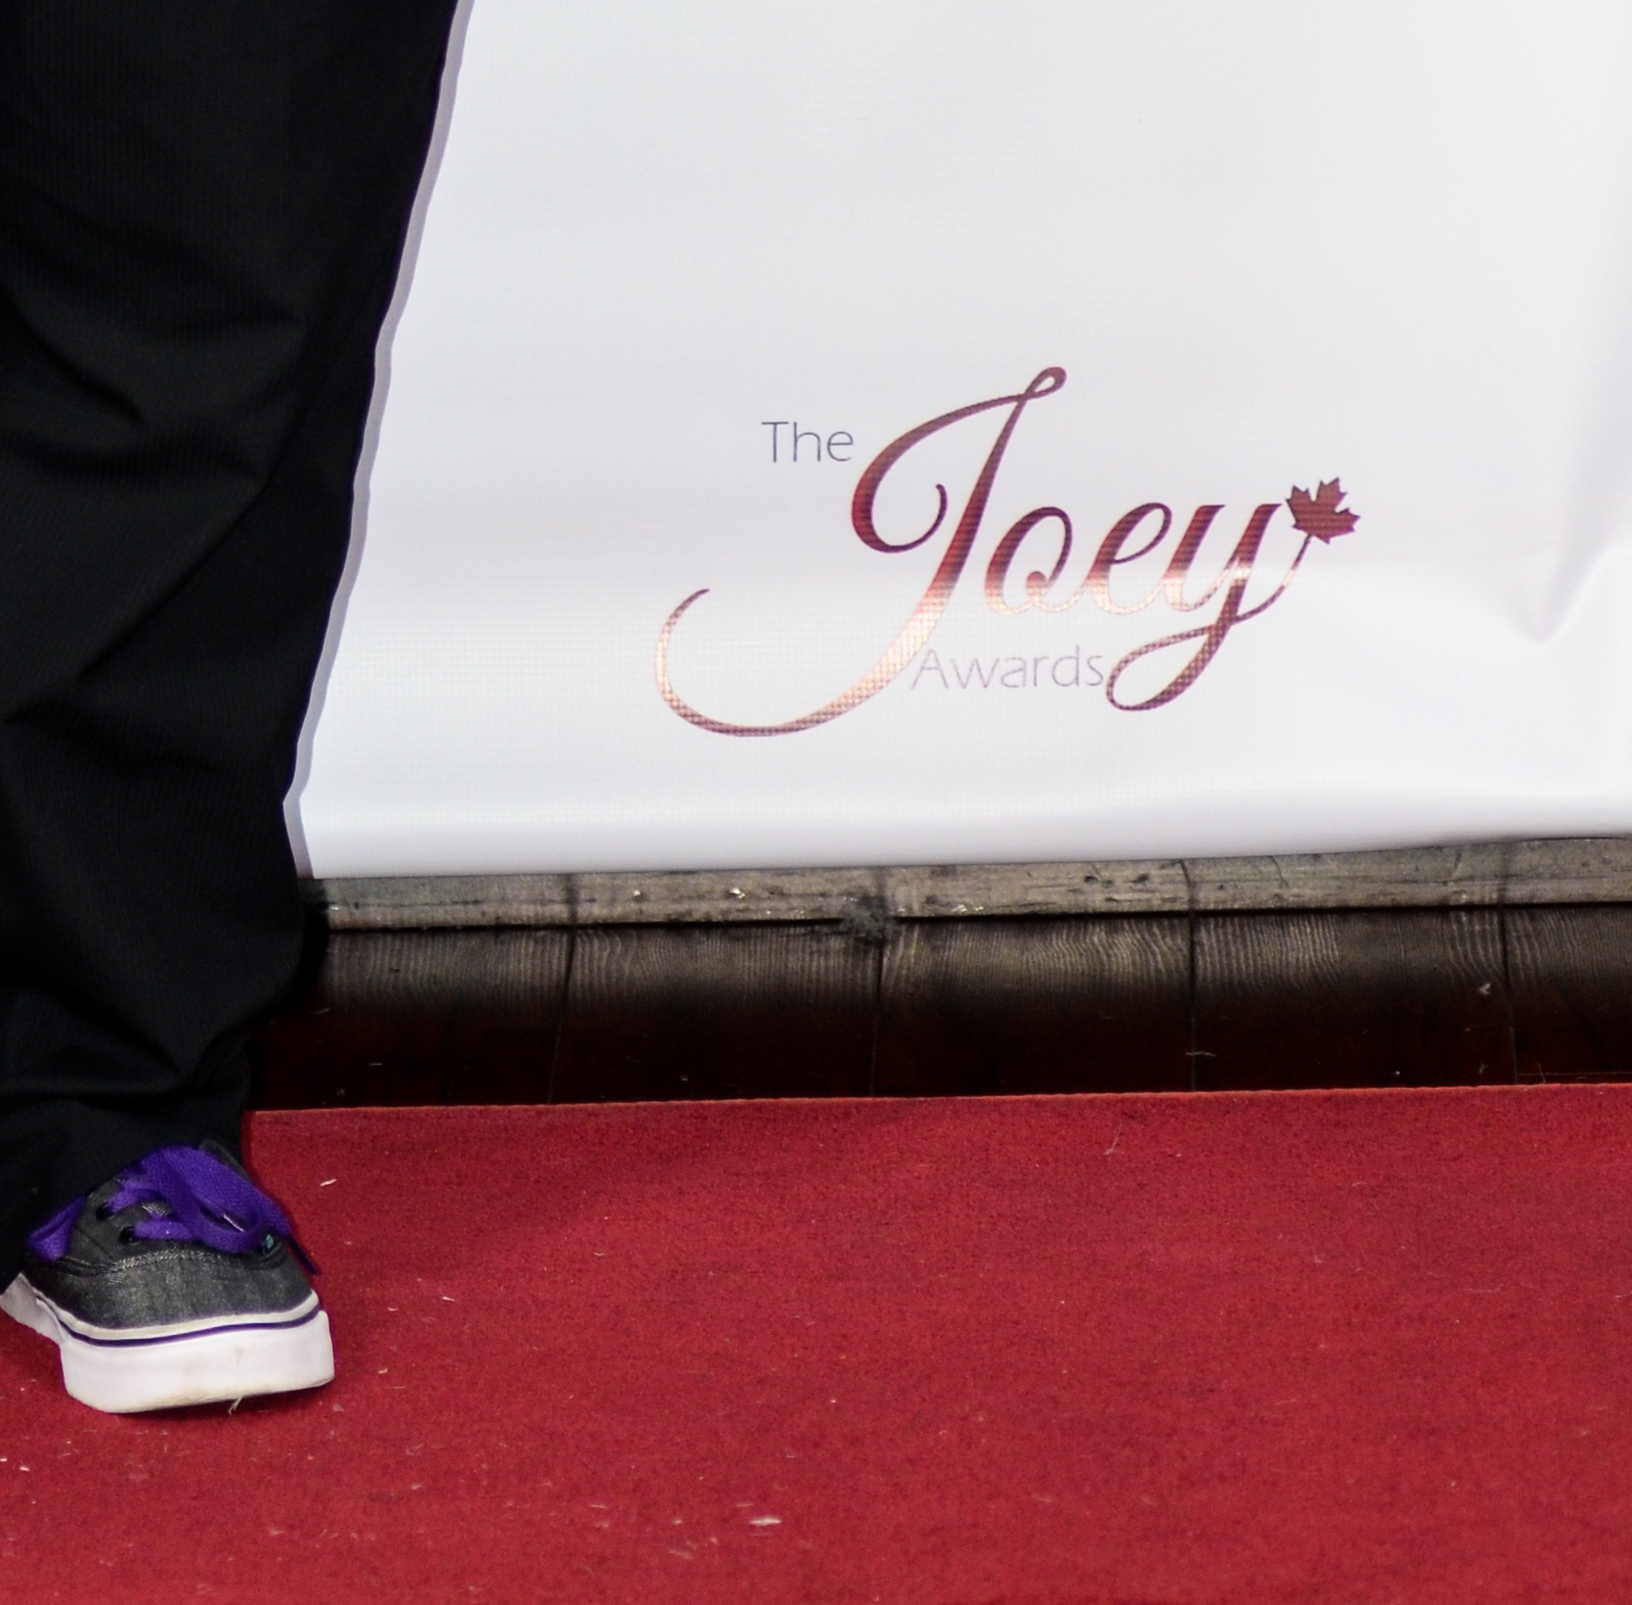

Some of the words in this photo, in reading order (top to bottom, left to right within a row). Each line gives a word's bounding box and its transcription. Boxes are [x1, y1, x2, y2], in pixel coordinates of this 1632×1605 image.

[762, 421, 854, 463] The
[654, 367, 1311, 738] Joey
[910, 644, 1106, 690] Awards
